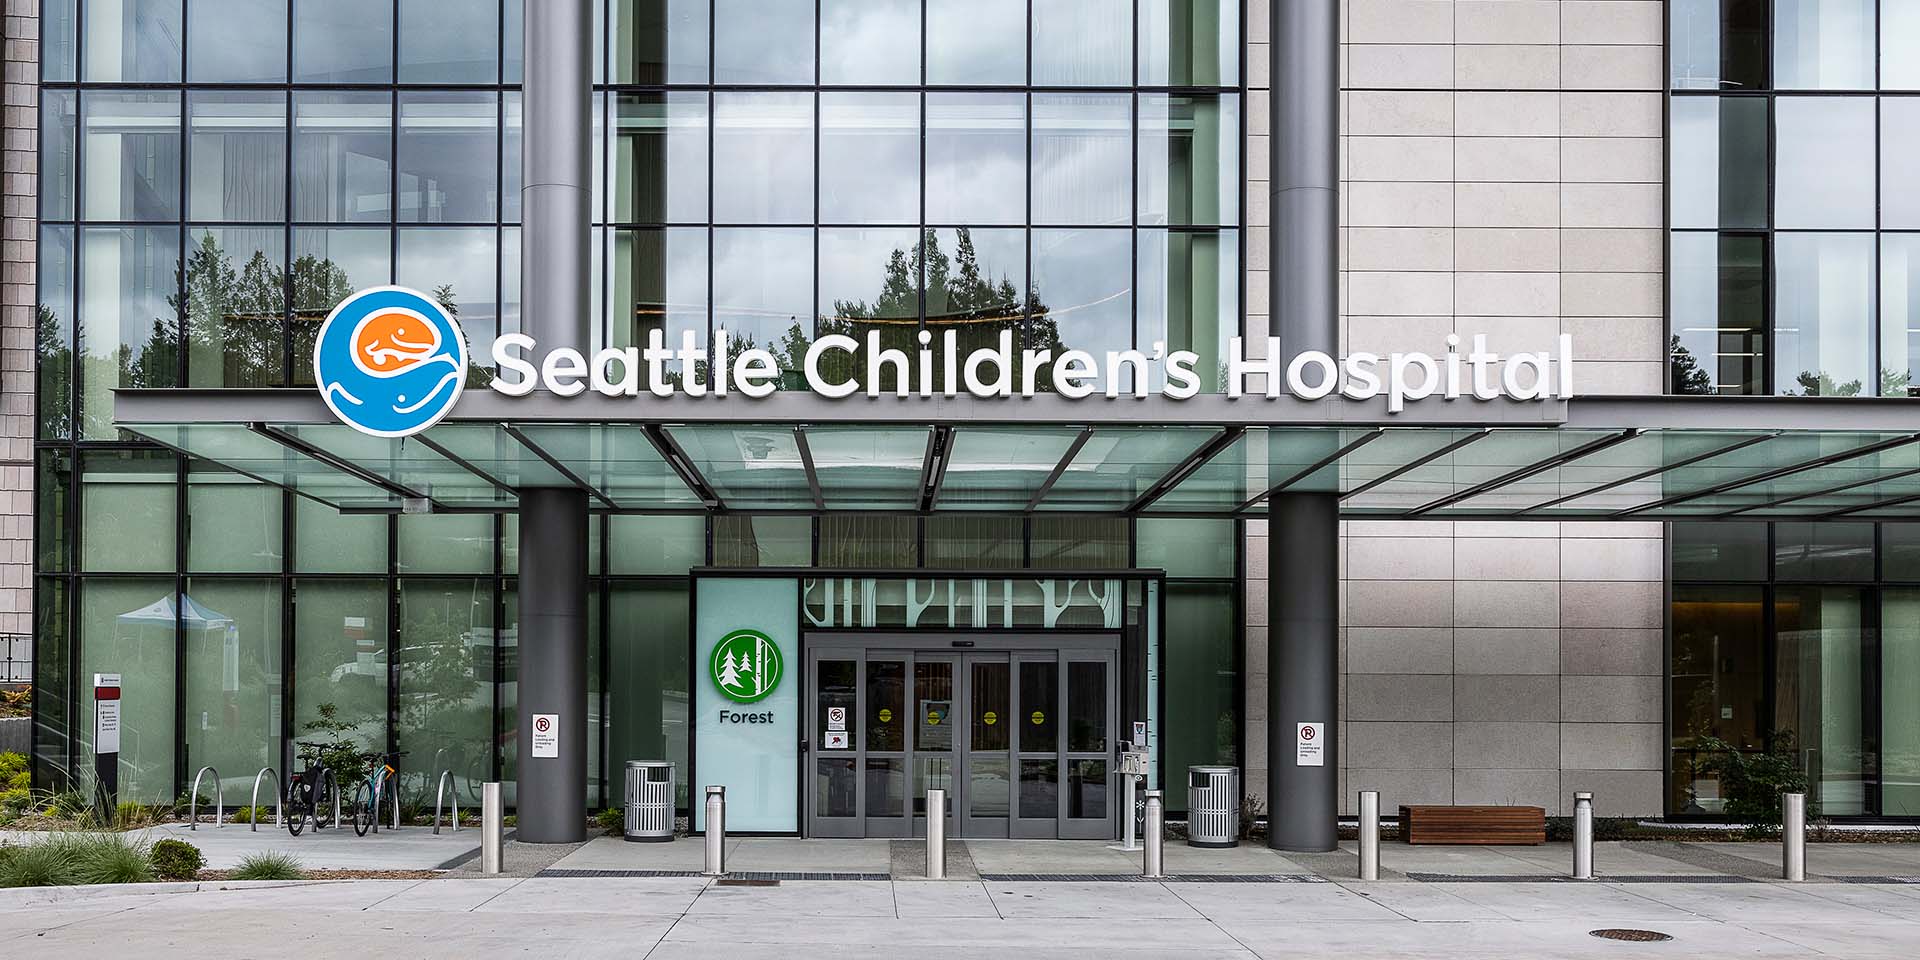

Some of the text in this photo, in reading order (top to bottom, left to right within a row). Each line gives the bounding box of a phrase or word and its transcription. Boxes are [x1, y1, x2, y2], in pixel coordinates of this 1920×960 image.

[490, 328, 1574, 414] Seattle Children's Hospital
[719, 710, 774, 724] Forest
